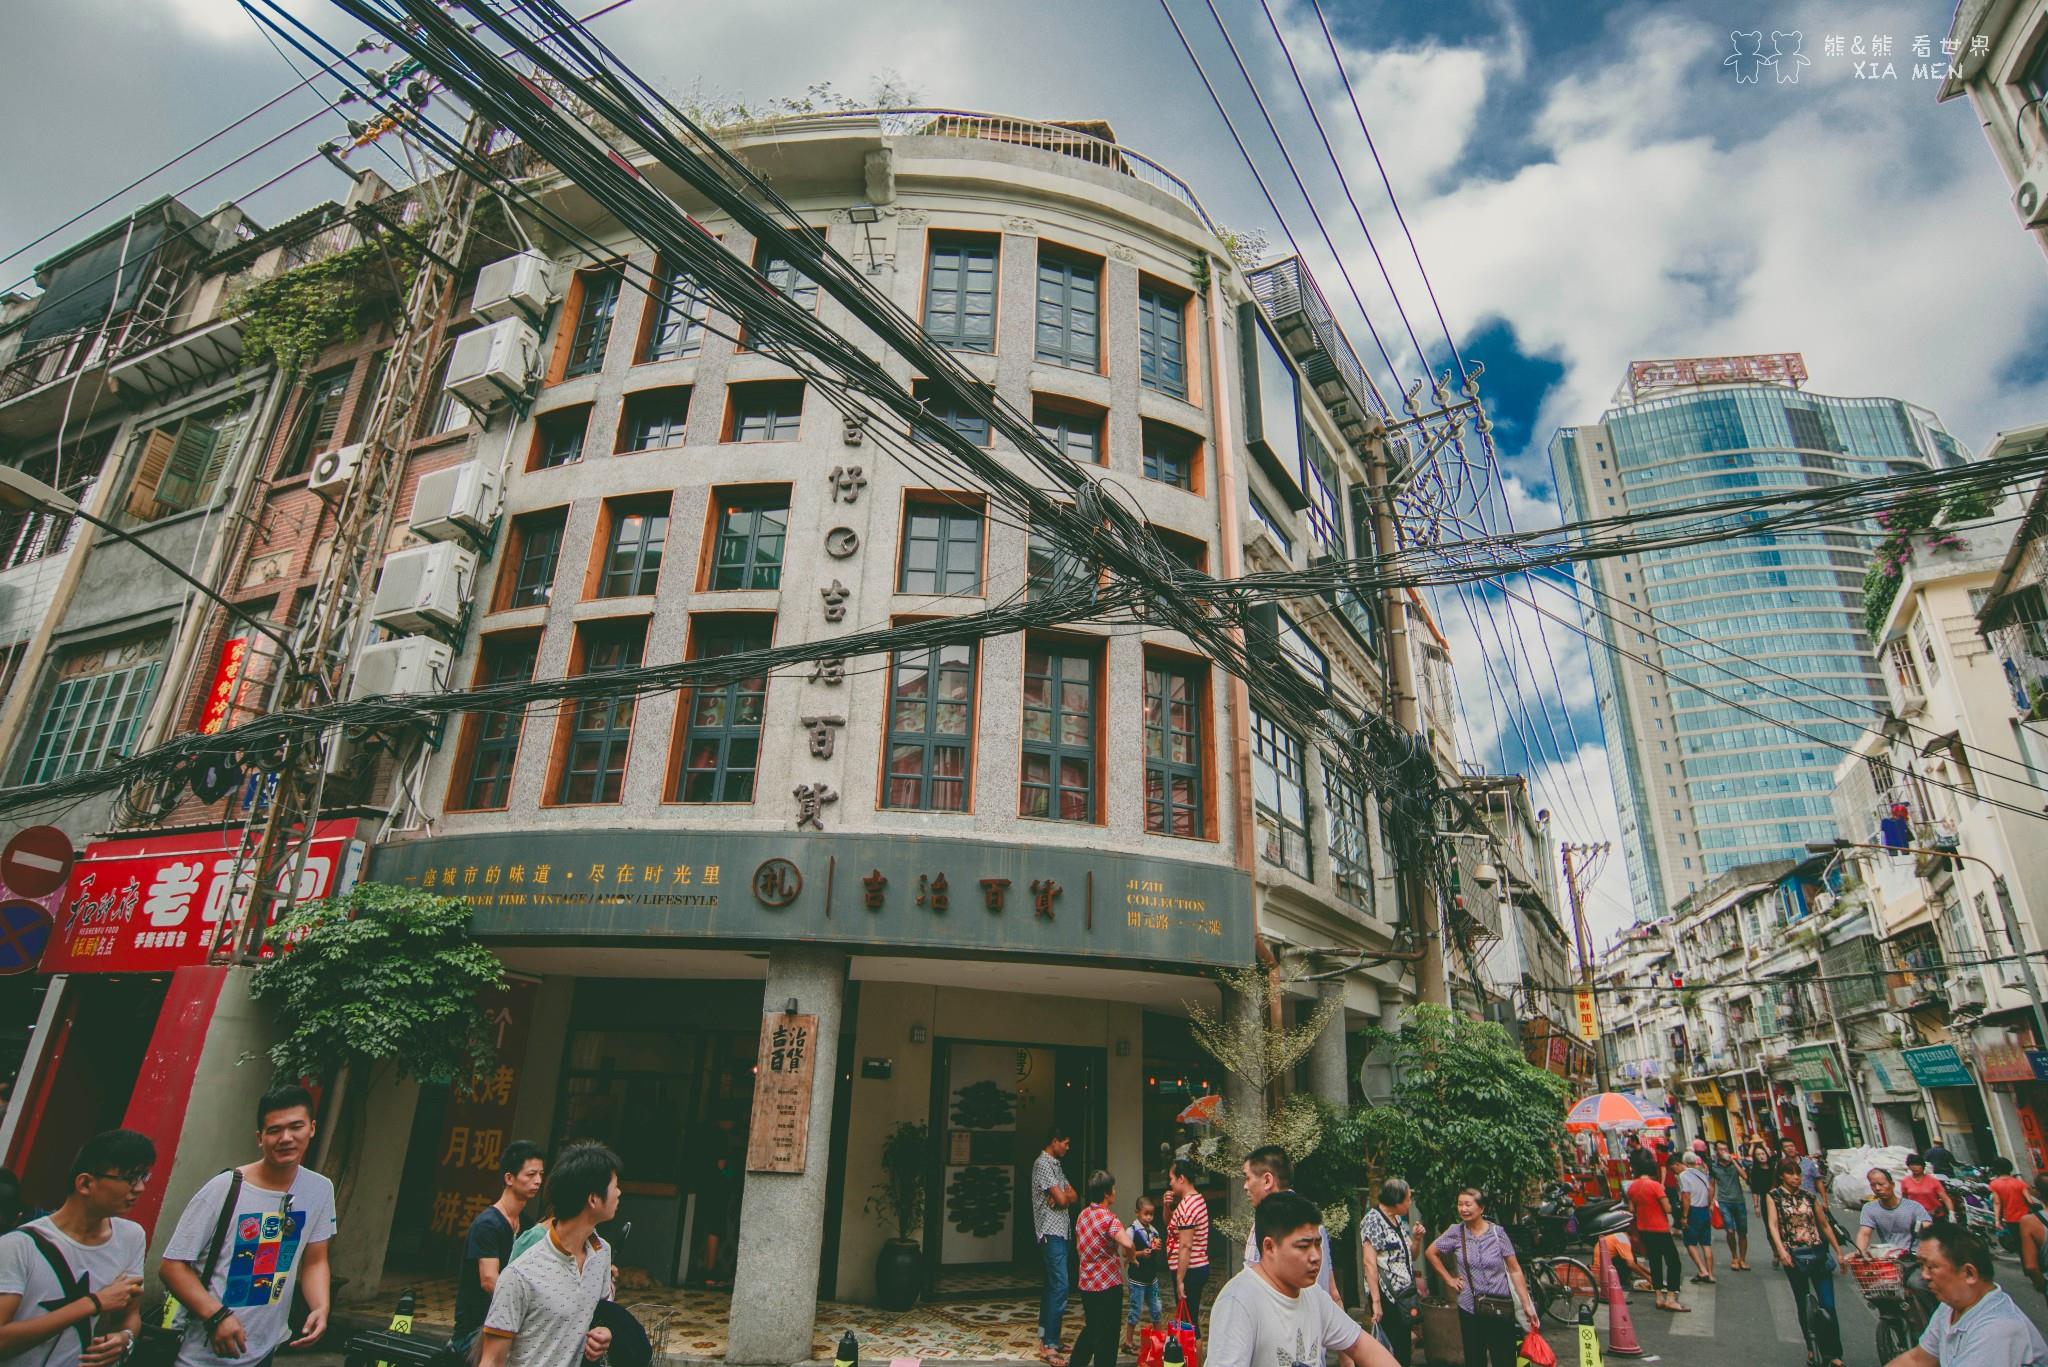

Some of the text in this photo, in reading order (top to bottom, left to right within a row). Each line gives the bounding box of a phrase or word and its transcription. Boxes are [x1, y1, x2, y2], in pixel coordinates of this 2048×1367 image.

[498, 894, 527, 905] TIME
[862, 868, 1063, 919] 吉治百貨
[1126, 894, 1206, 913] COLLECTION
